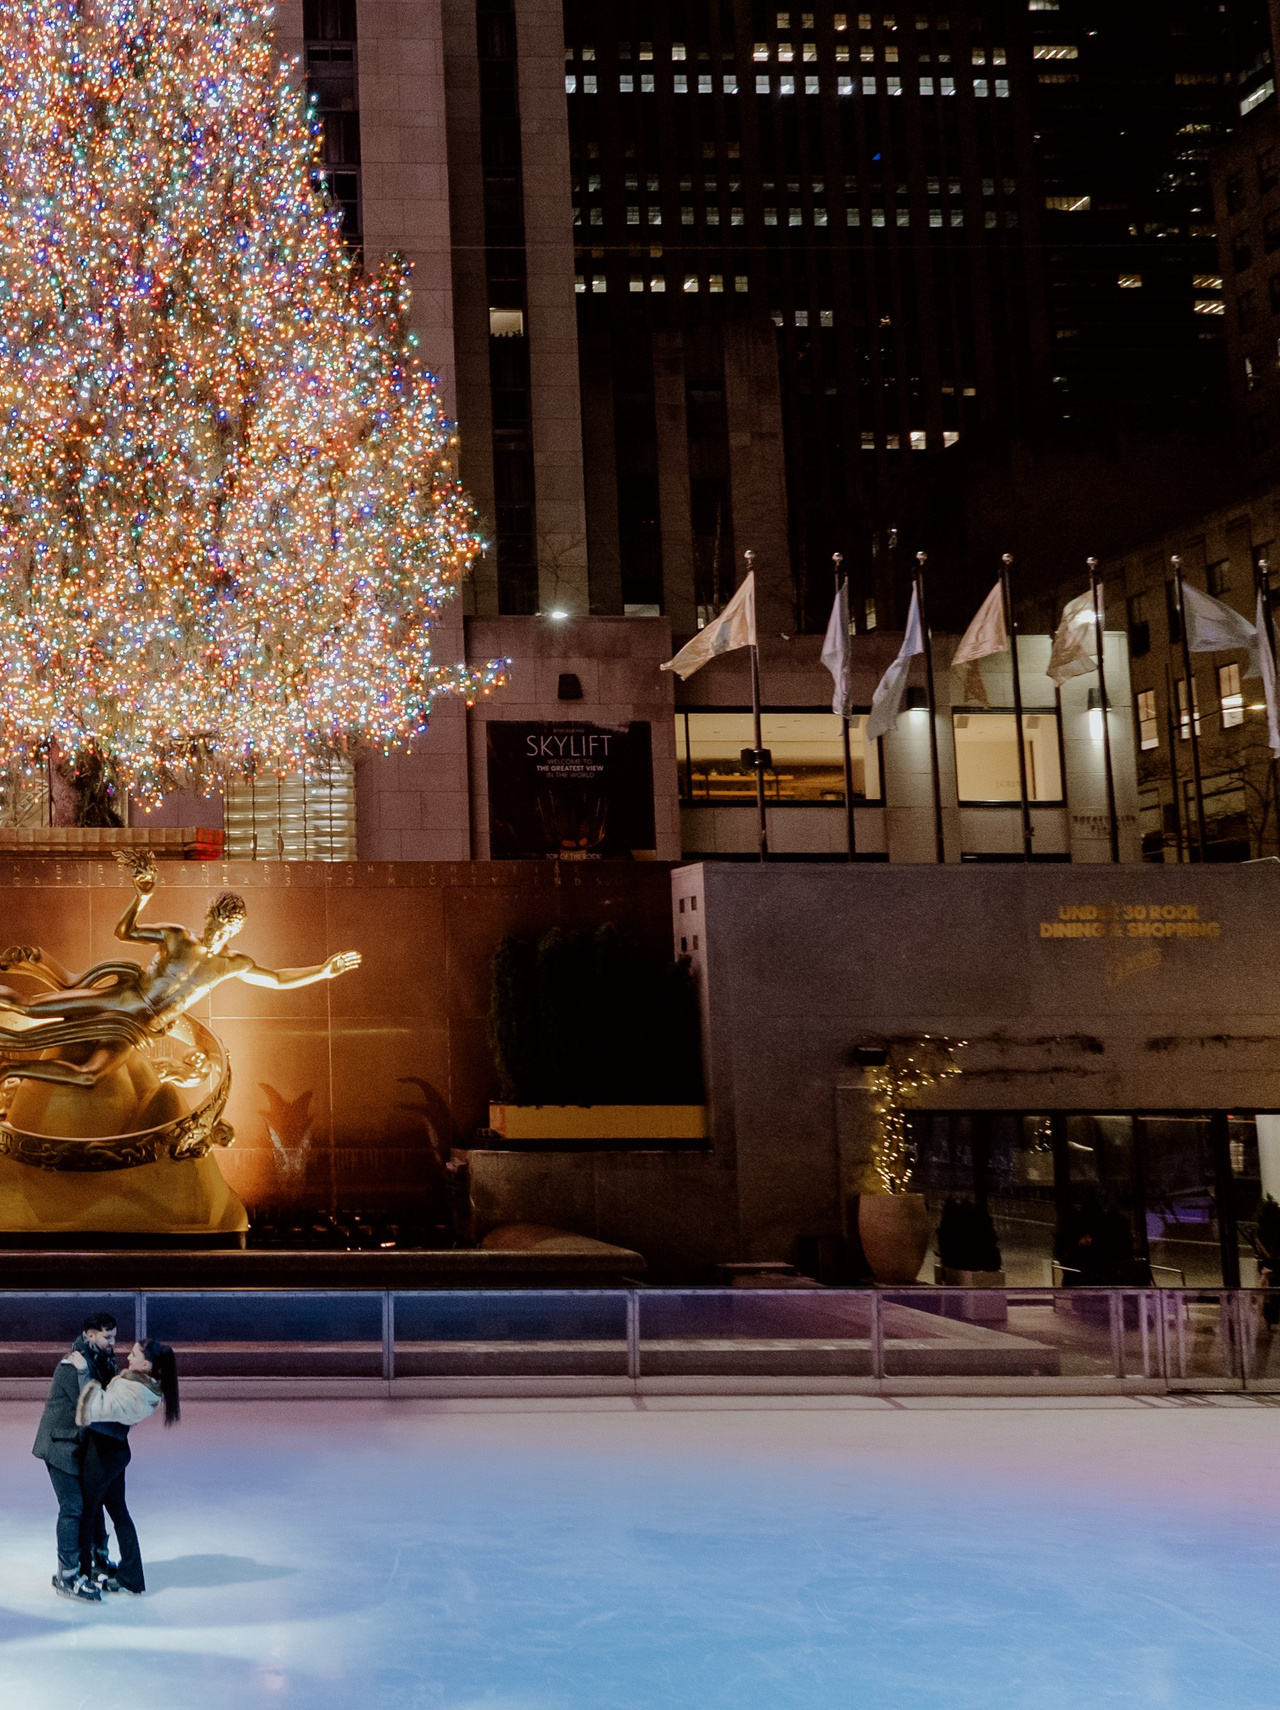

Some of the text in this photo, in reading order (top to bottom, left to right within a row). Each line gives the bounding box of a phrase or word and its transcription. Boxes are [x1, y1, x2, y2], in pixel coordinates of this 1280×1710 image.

[526, 735, 613, 756] SKYLIFT
[1122, 905, 1146, 920] 30
[1150, 905, 1199, 920] ROCK
[1040, 922, 1104, 938] DINING
[1127, 922, 1220, 937] SHOPPING
